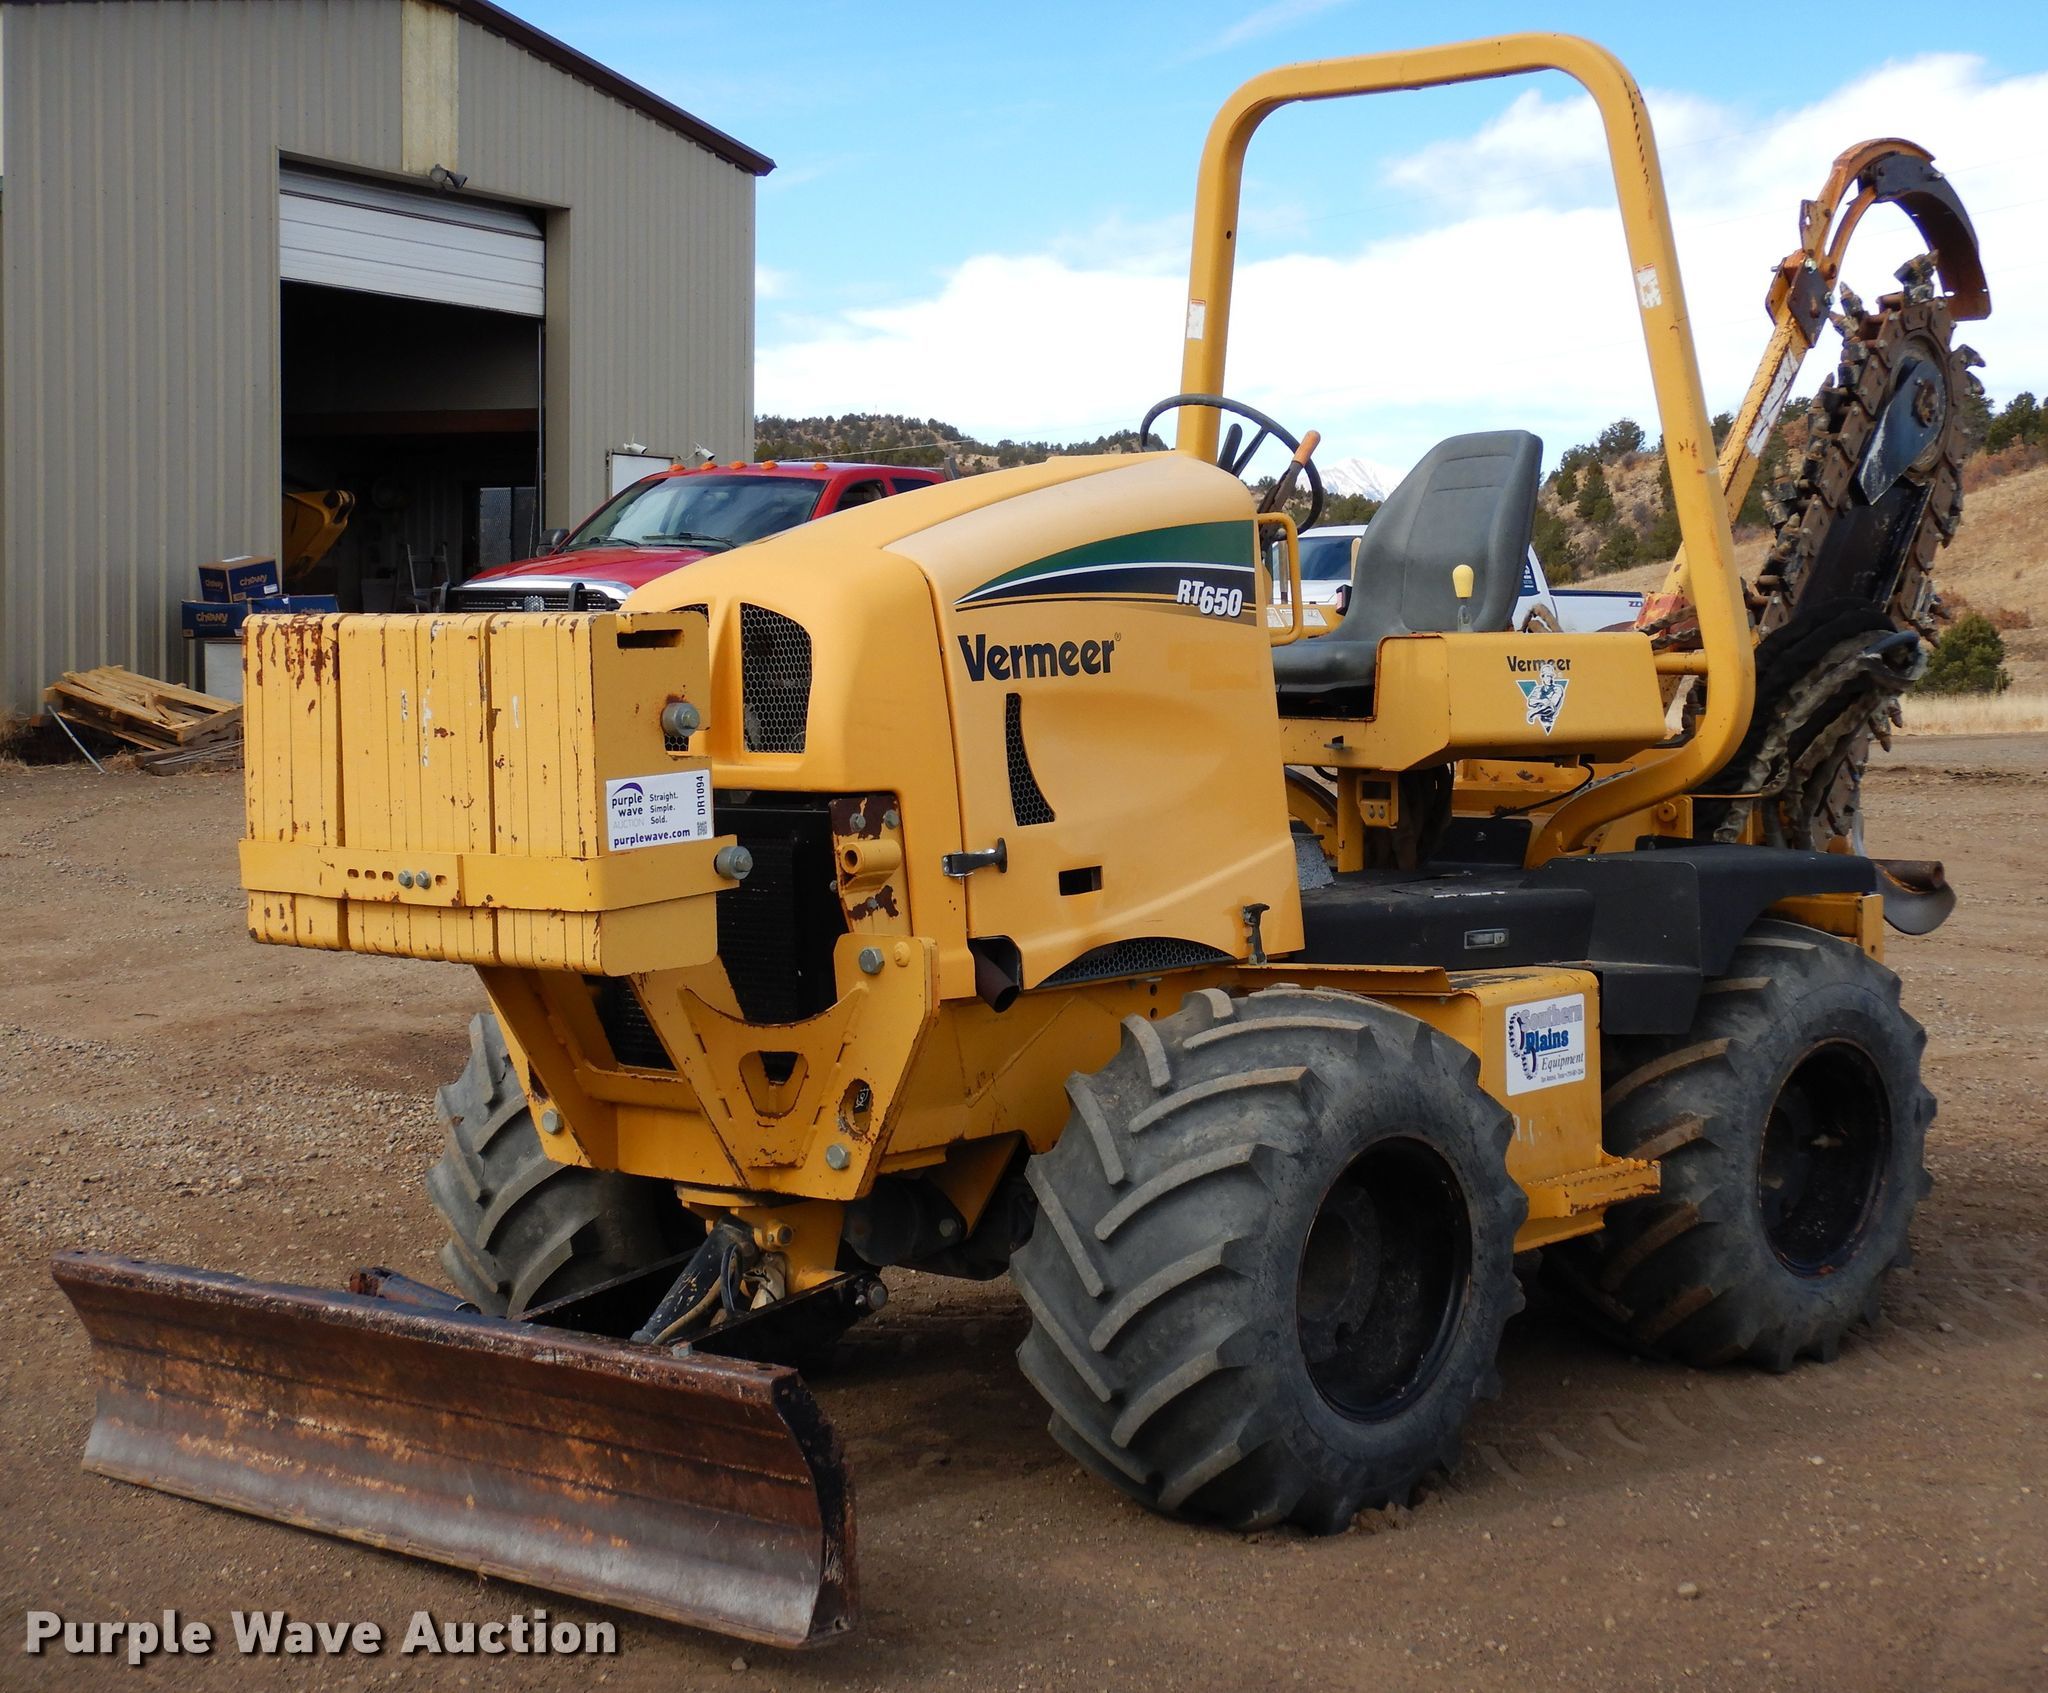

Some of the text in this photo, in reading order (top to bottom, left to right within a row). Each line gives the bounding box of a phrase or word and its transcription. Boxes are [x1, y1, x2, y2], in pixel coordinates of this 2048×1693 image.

[239, 574, 268, 587] chewy
[1177, 579, 1243, 617] RT650
[196, 612, 229, 623] chewy
[612, 793, 643, 809] purple
[649, 792, 679, 802] Straight.
[696, 776, 706, 815] DR1094
[618, 807, 643, 817] wave
[650, 803, 676, 814] Simple.
[650, 816, 668, 825] Sold.
[614, 829, 691, 848] purplewave.com
[1520, 1004, 1582, 1032] Southern
[1523, 1028, 1569, 1055] Plains
[1541, 1052, 1584, 1073] Equipment
